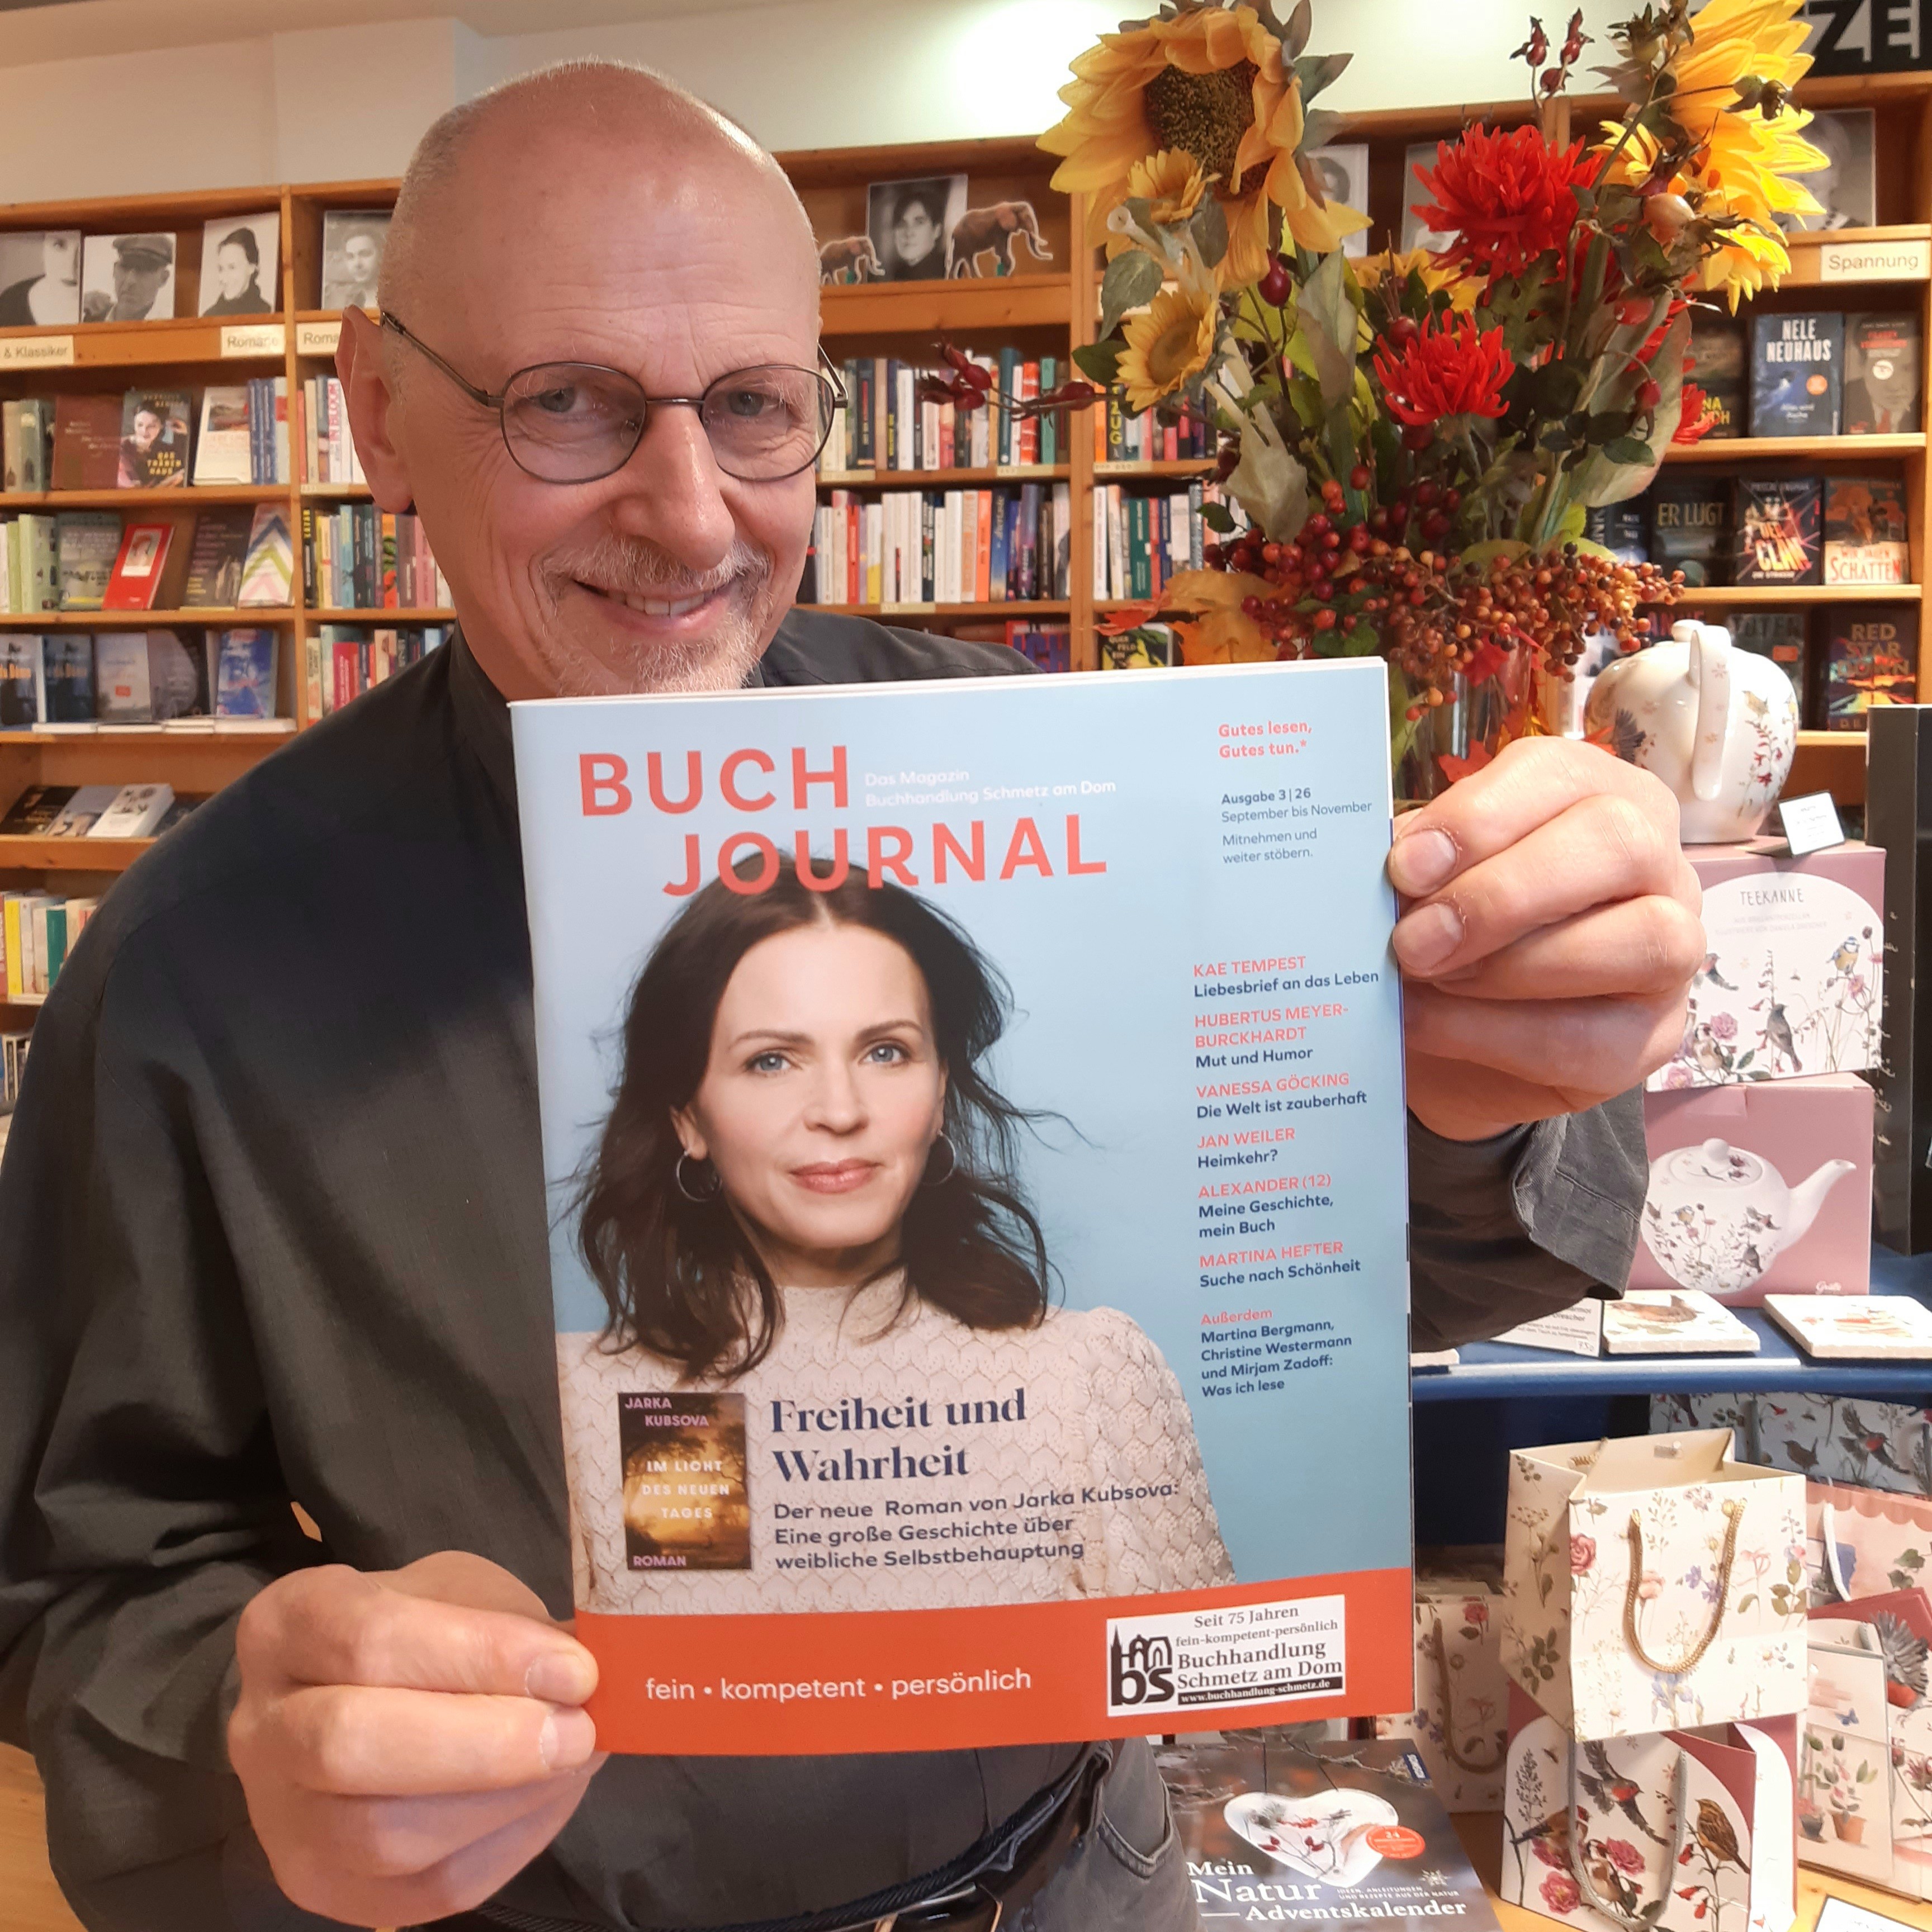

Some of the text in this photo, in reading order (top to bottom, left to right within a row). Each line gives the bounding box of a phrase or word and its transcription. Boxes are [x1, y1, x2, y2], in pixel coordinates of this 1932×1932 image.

[1829, 254, 1919, 271] Spannung
[1782, 318, 1816, 340] NELE
[3, 345, 68, 359] & Klassiker
[1766, 339, 1832, 362] NEUHAUS
[1657, 502, 1679, 527] ER
[1755, 537, 1812, 571] CLAN
[1830, 555, 1902, 581] SCHATTEN
[1851, 623, 1897, 642] RED
[1845, 641, 1901, 659] STAR
[1218, 720, 1312, 737] Gutes lesen,
[1219, 744, 1265, 759] Gutes
[579, 745, 849, 816] BUCH
[865, 769, 969, 787] Das Magazin
[865, 781, 1116, 807] Buchhandlung Schmetz am Dom
[1221, 790, 1275, 806] Ausgabe
[1221, 801, 1372, 824] September bis November
[1223, 828, 1318, 846] Mitnehmen und
[662, 813, 1107, 897] JOURNAL
[1223, 848, 1313, 864] weiter stöbern.
[1740, 888, 1805, 906] TEEKANNE
[1194, 955, 1306, 977] KAE TEMPEST
[1194, 970, 1379, 998] Liebesbrief an das Leben
[1194, 1003, 1349, 1027] HUBERTUS MEYER-
[1195, 1026, 1307, 1049] BURCKHARDT
[1196, 1048, 1314, 1068] Mut und Humor
[1196, 1072, 1350, 1099] VANESSA GÖCKING
[1197, 1091, 1367, 1119] Die Welt ist zauberhaft
[1197, 1127, 1296, 1149] JAN WEILER
[1198, 1149, 1278, 1168] Heimkehr?
[1198, 1173, 1332, 1199] ALEXANDER (12)
[1199, 1195, 1334, 1218] Meine Geschichte,
[1199, 1219, 1276, 1238] mein Buch
[1199, 1240, 1344, 1268] MARTINA HEFTER
[1200, 1258, 1361, 1287] Suche nach Schönheit
[1201, 1309, 1273, 1325] Außerdem
[1201, 1320, 1335, 1343] Martina Bergmann,
[1201, 1336, 1352, 1362] Christine Westermann
[1201, 1353, 1334, 1380] und Mirjam Zadoff:
[1202, 1379, 1285, 1398] Was ich lese
[625, 1398, 672, 1409] JARKA
[770, 1386, 1027, 1433] Freiheit und
[645, 1415, 709, 1427] KUBSOVA
[647, 1460, 723, 1472] IM LICHT
[772, 1445, 970, 1483] Wahrheit
[642, 1484, 730, 1496] DES NEUEN
[774, 1483, 1180, 1519] Der neue Roman von Jarka Kubsova:
[661, 1508, 713, 1519] TAGES
[775, 1517, 1073, 1547] Eine große Geschichte über
[633, 1555, 687, 1567] ROMAN
[775, 1543, 1084, 1570] weibliche Selbstbehauptung
[1194, 1606, 1300, 1628] Seit 75 Jahren
[1176, 1620, 1339, 1647] fein-kompetent-persönlich
[1177, 1641, 1327, 1670] Buchhandlung
[646, 1666, 1032, 1703] fein kompetent persönlich
[1177, 1660, 1343, 1690] Schmetz am Dom
[1181, 1679, 1330, 1703] www.buchhandlung-schmetz.de
[1186, 1860, 1253, 1877] Mein
[1192, 1877, 1322, 1905] Natur
[1245, 1900, 1467, 1921] Adventskalender
